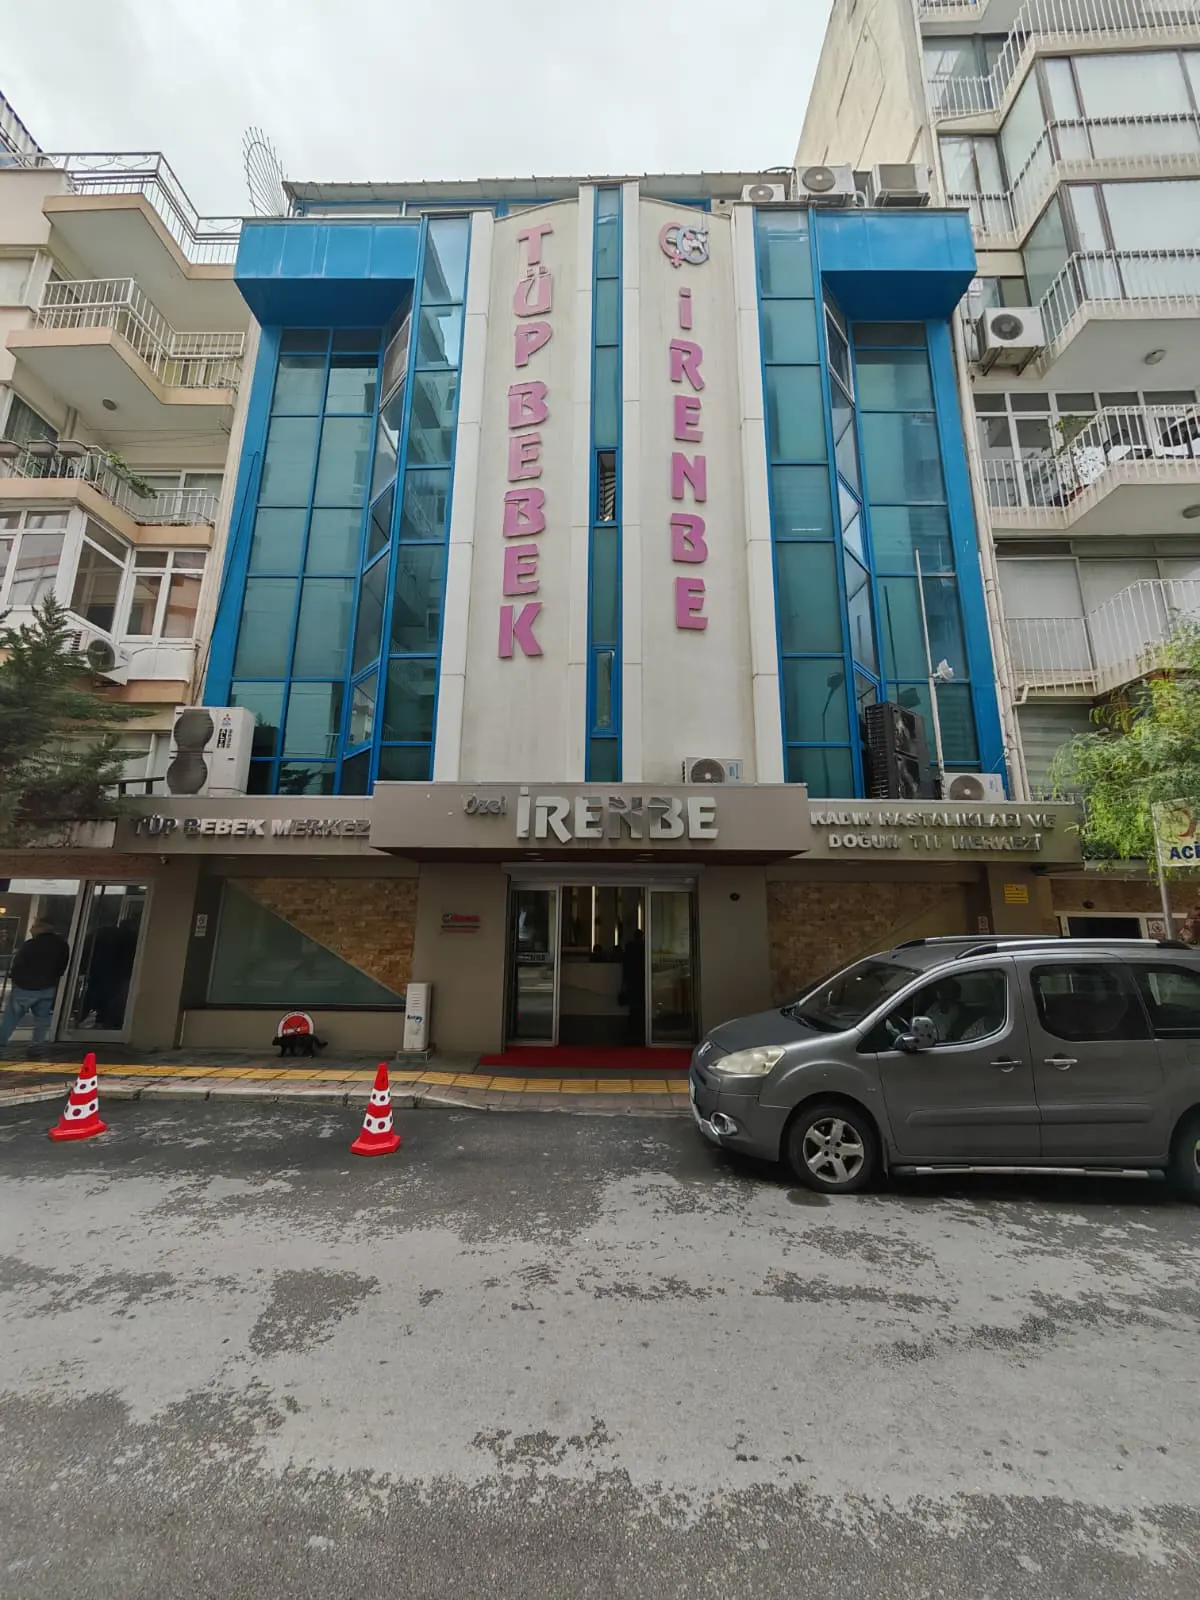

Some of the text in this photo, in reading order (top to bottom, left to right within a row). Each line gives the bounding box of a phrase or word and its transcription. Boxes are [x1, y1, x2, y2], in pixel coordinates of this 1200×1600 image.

[497, 223, 554, 659] TÜP BEBEK
[669, 287, 709, 631] İRENBE
[136, 814, 179, 836] TÜP
[184, 818, 265, 837] BEBEK
[516, 786, 719, 844] İRENBE
[810, 811, 873, 827] KADIN
